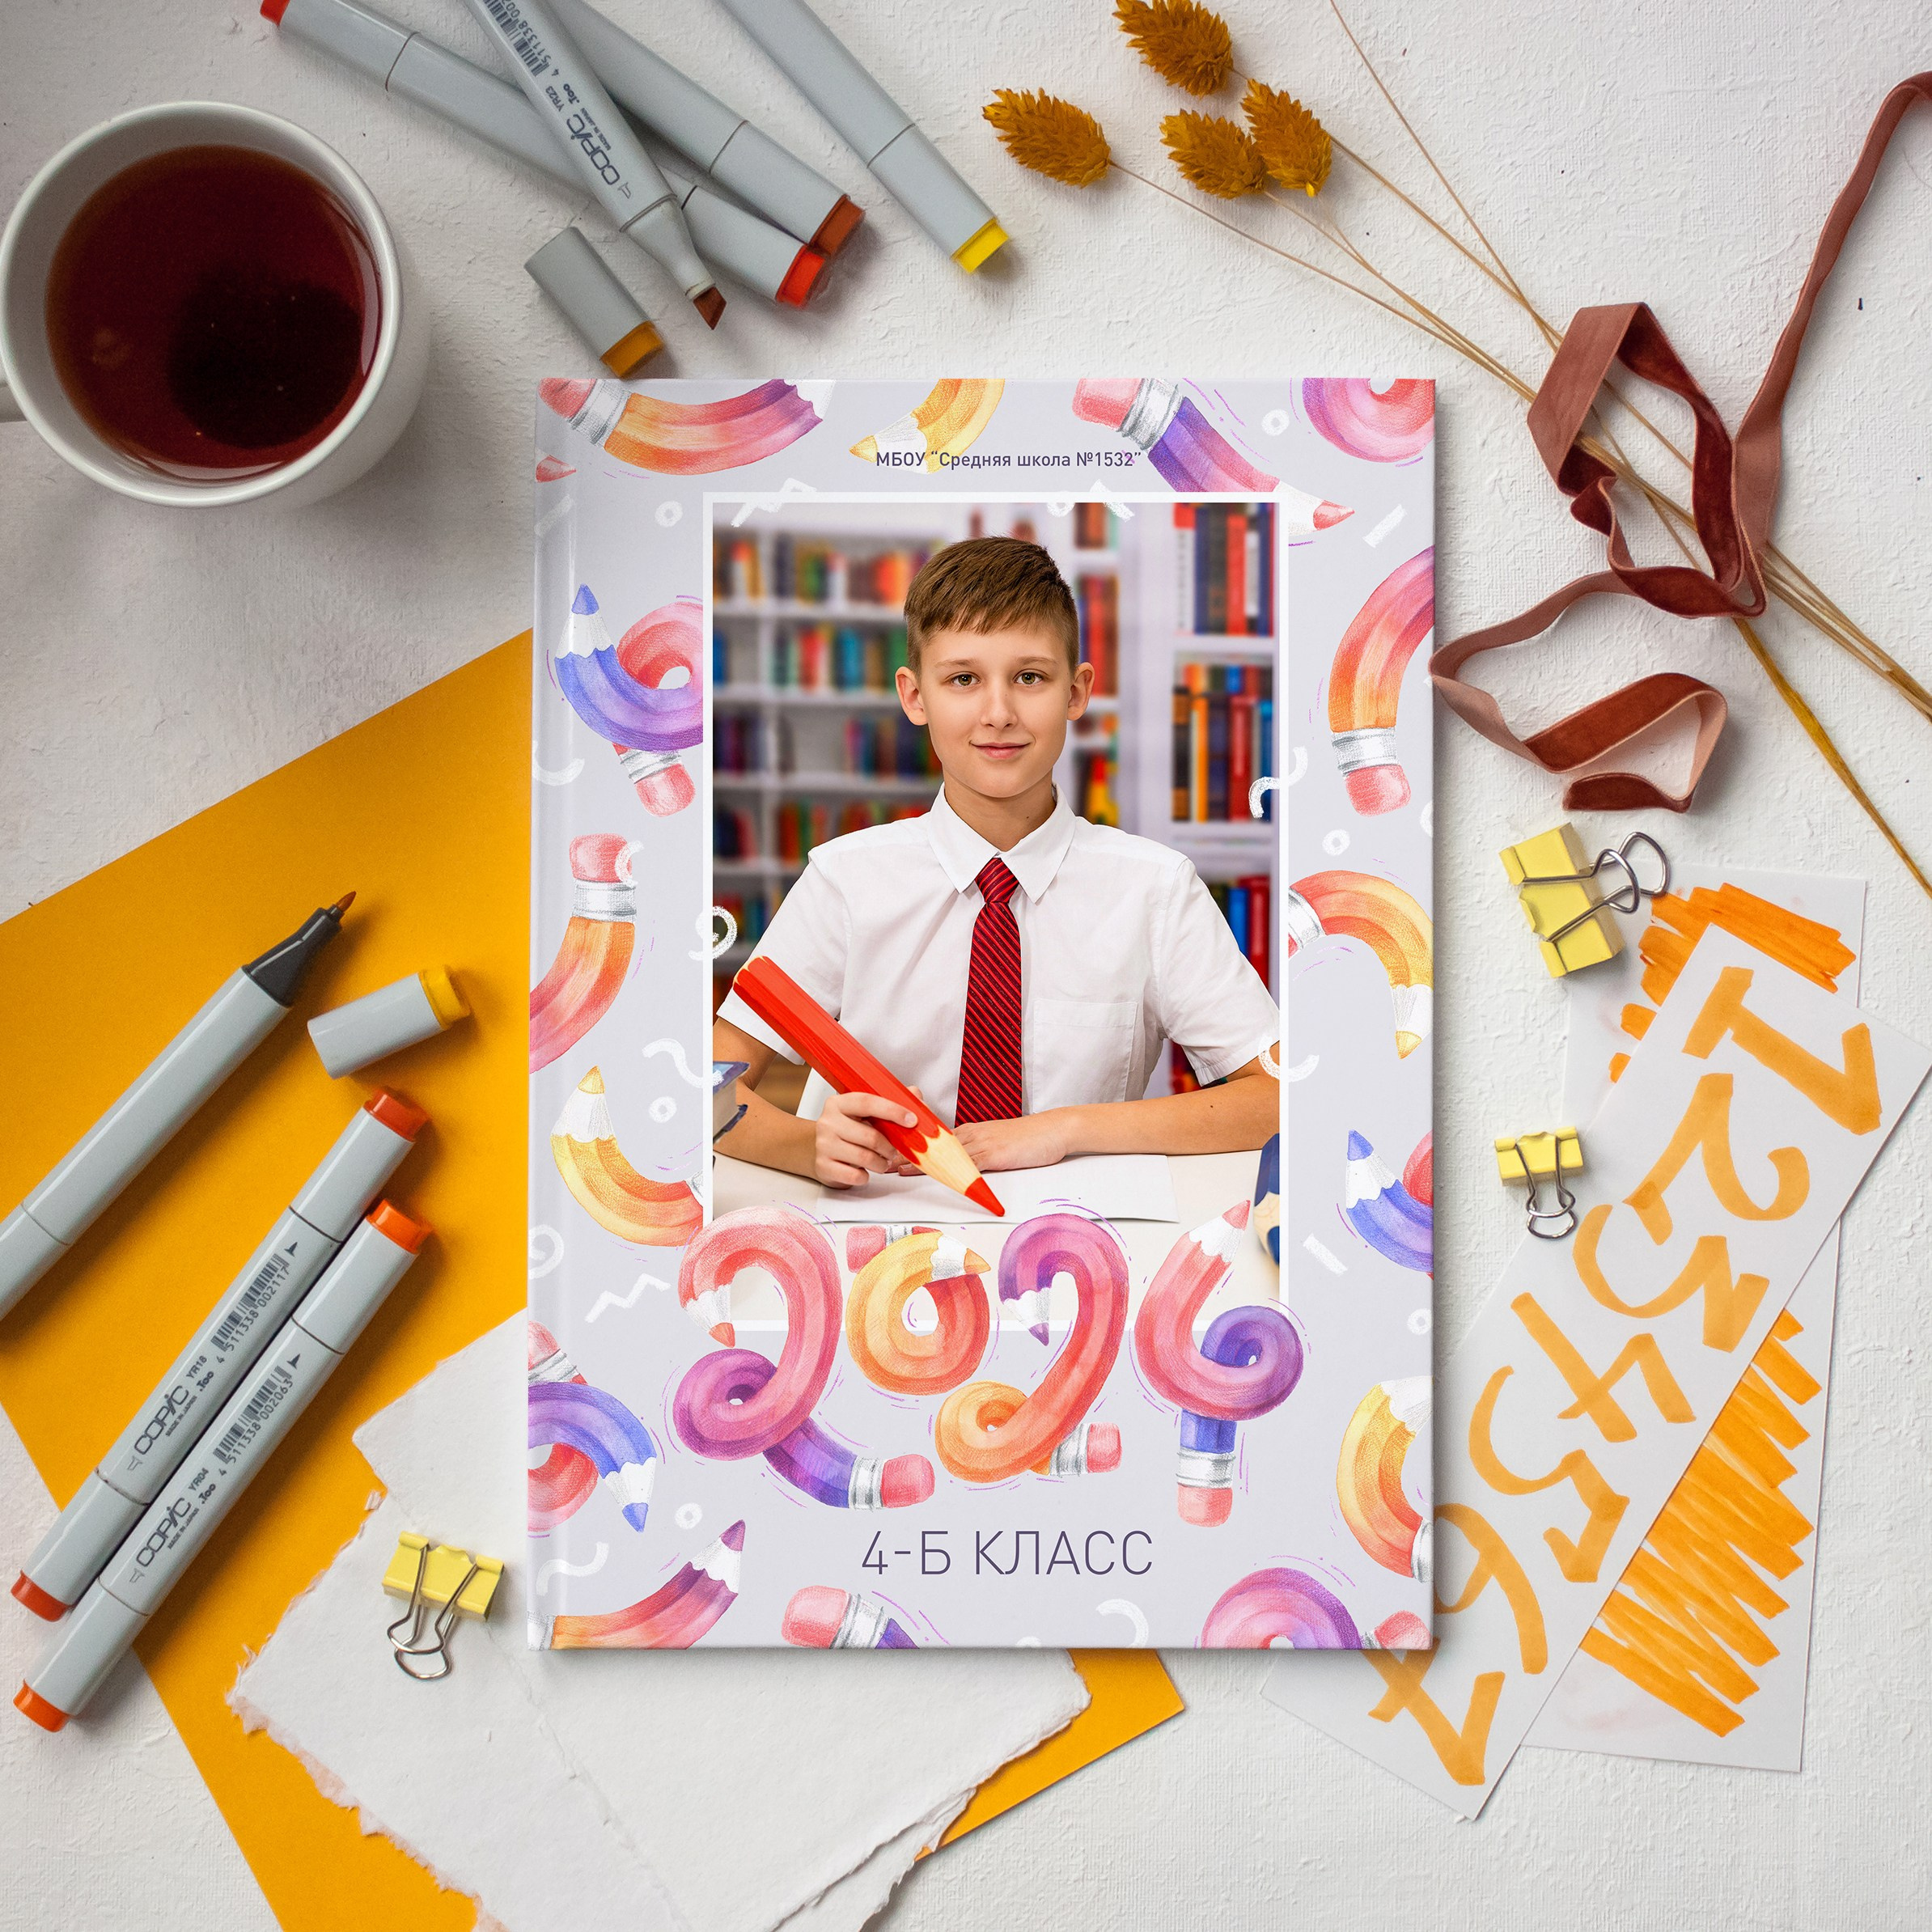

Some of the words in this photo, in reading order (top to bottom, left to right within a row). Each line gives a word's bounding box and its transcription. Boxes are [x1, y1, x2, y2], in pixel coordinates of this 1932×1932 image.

[545, 85, 565, 112] YR23
[876, 451, 926, 467] МБОУ
[1017, 452, 1071, 467] школа
[188, 1467, 210, 1491] YR04
[860, 1529, 951, 1576] 4-Б
[975, 1529, 1155, 1576] КЛАСС
